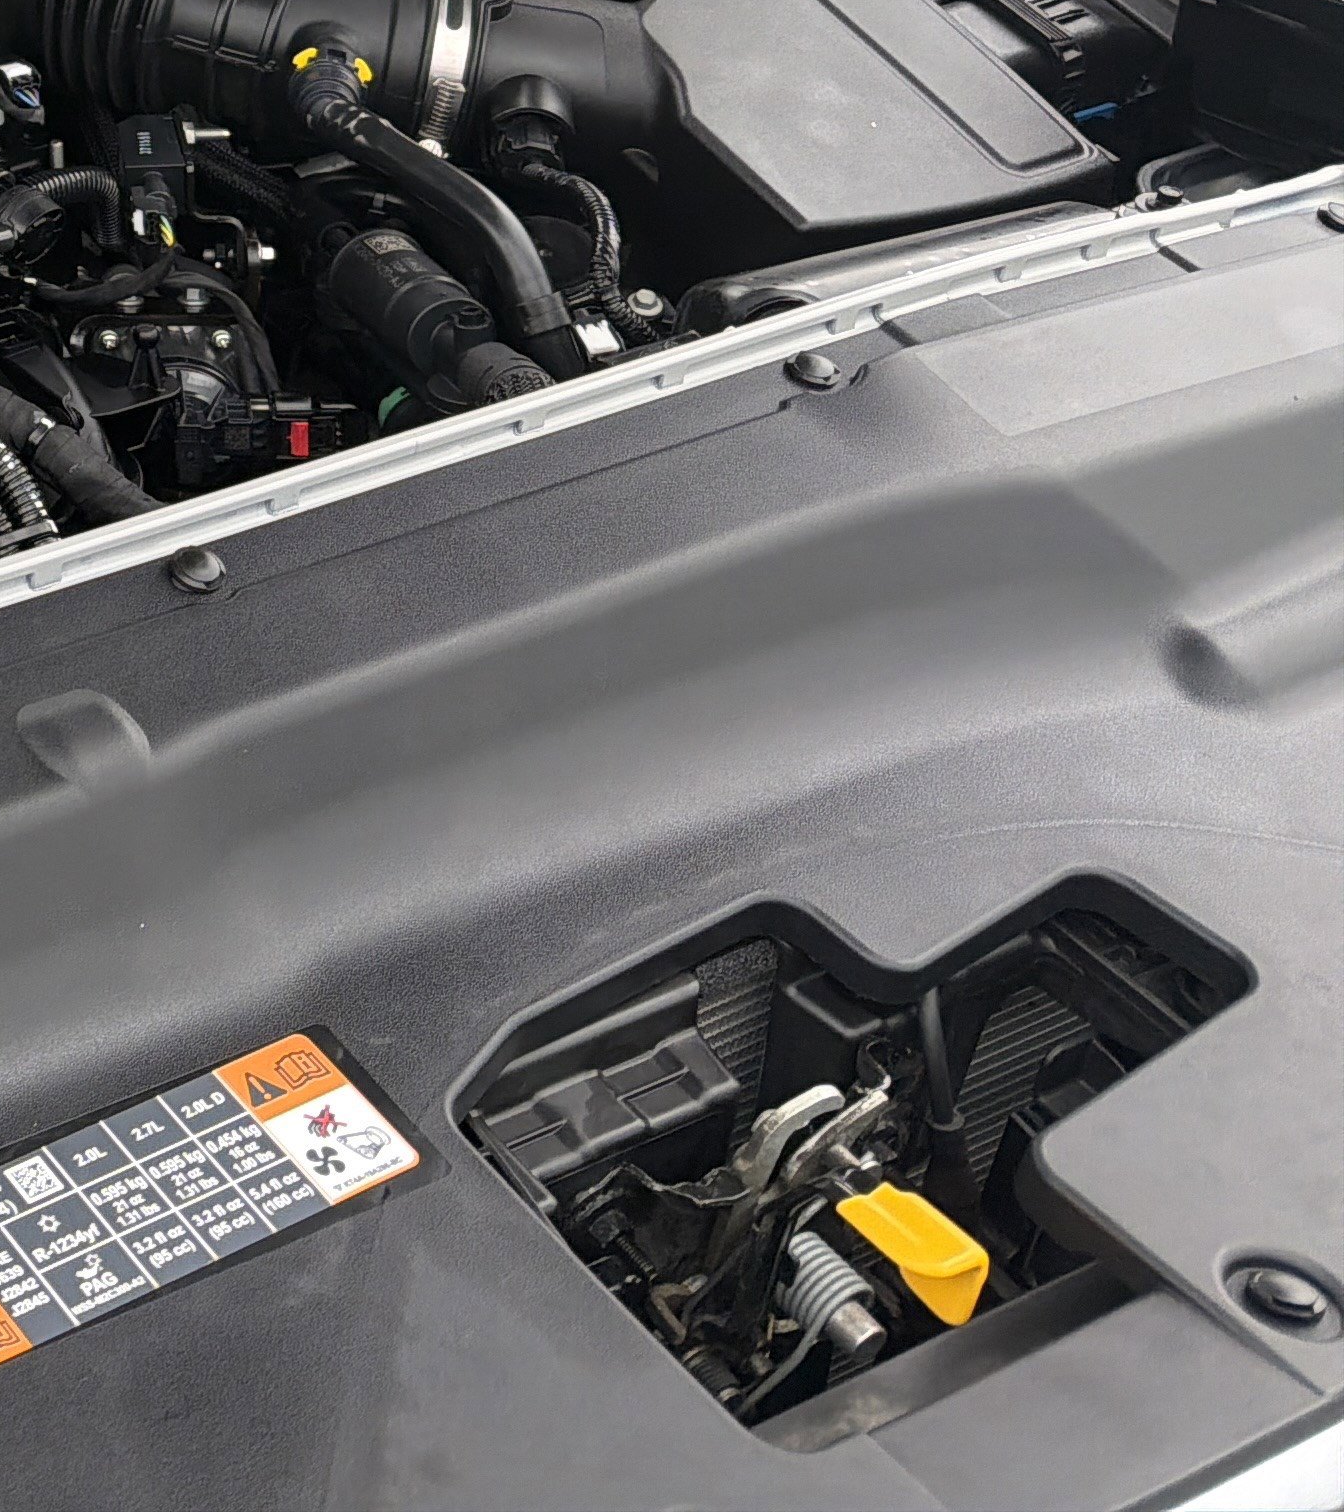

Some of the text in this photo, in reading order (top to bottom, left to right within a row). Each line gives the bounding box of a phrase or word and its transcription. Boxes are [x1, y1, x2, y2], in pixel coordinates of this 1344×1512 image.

[180, 1091, 226, 1119] 2.0L D
[130, 1120, 166, 1142] 2.7L
[205, 1123, 263, 1154] 0.454 kg
[72, 1146, 109, 1168] 2.0L
[228, 1140, 261, 1160] 16 oz
[232, 1150, 277, 1174] 1.00 lbs
[148, 1149, 207, 1180] 0.595 kg
[170, 1166, 205, 1187] 21 oz
[89, 1175, 149, 1207] 0.595 kg
[175, 1176, 220, 1201] 1.31 lbs
[248, 1171, 302, 1201] 5.4 fl oz
[261, 1183, 316, 1216] (160 cc)
[111, 1193, 147, 1214] 21 oz
[116, 1202, 162, 1227] 1.31 lbs
[191, 1197, 246, 1228] 3.2 fl oz
[131, 1224, 187, 1255] 3.2 fl oz
[208, 1211, 256, 1242] (95 cc)
[31, 1222, 101, 1264] R-1234yf
[148, 1238, 197, 1269] (95 cc)
[0, 1276, 40, 1303] J2842
[78, 1271, 119, 1297] PAG
[11, 1291, 51, 1318] J2845
